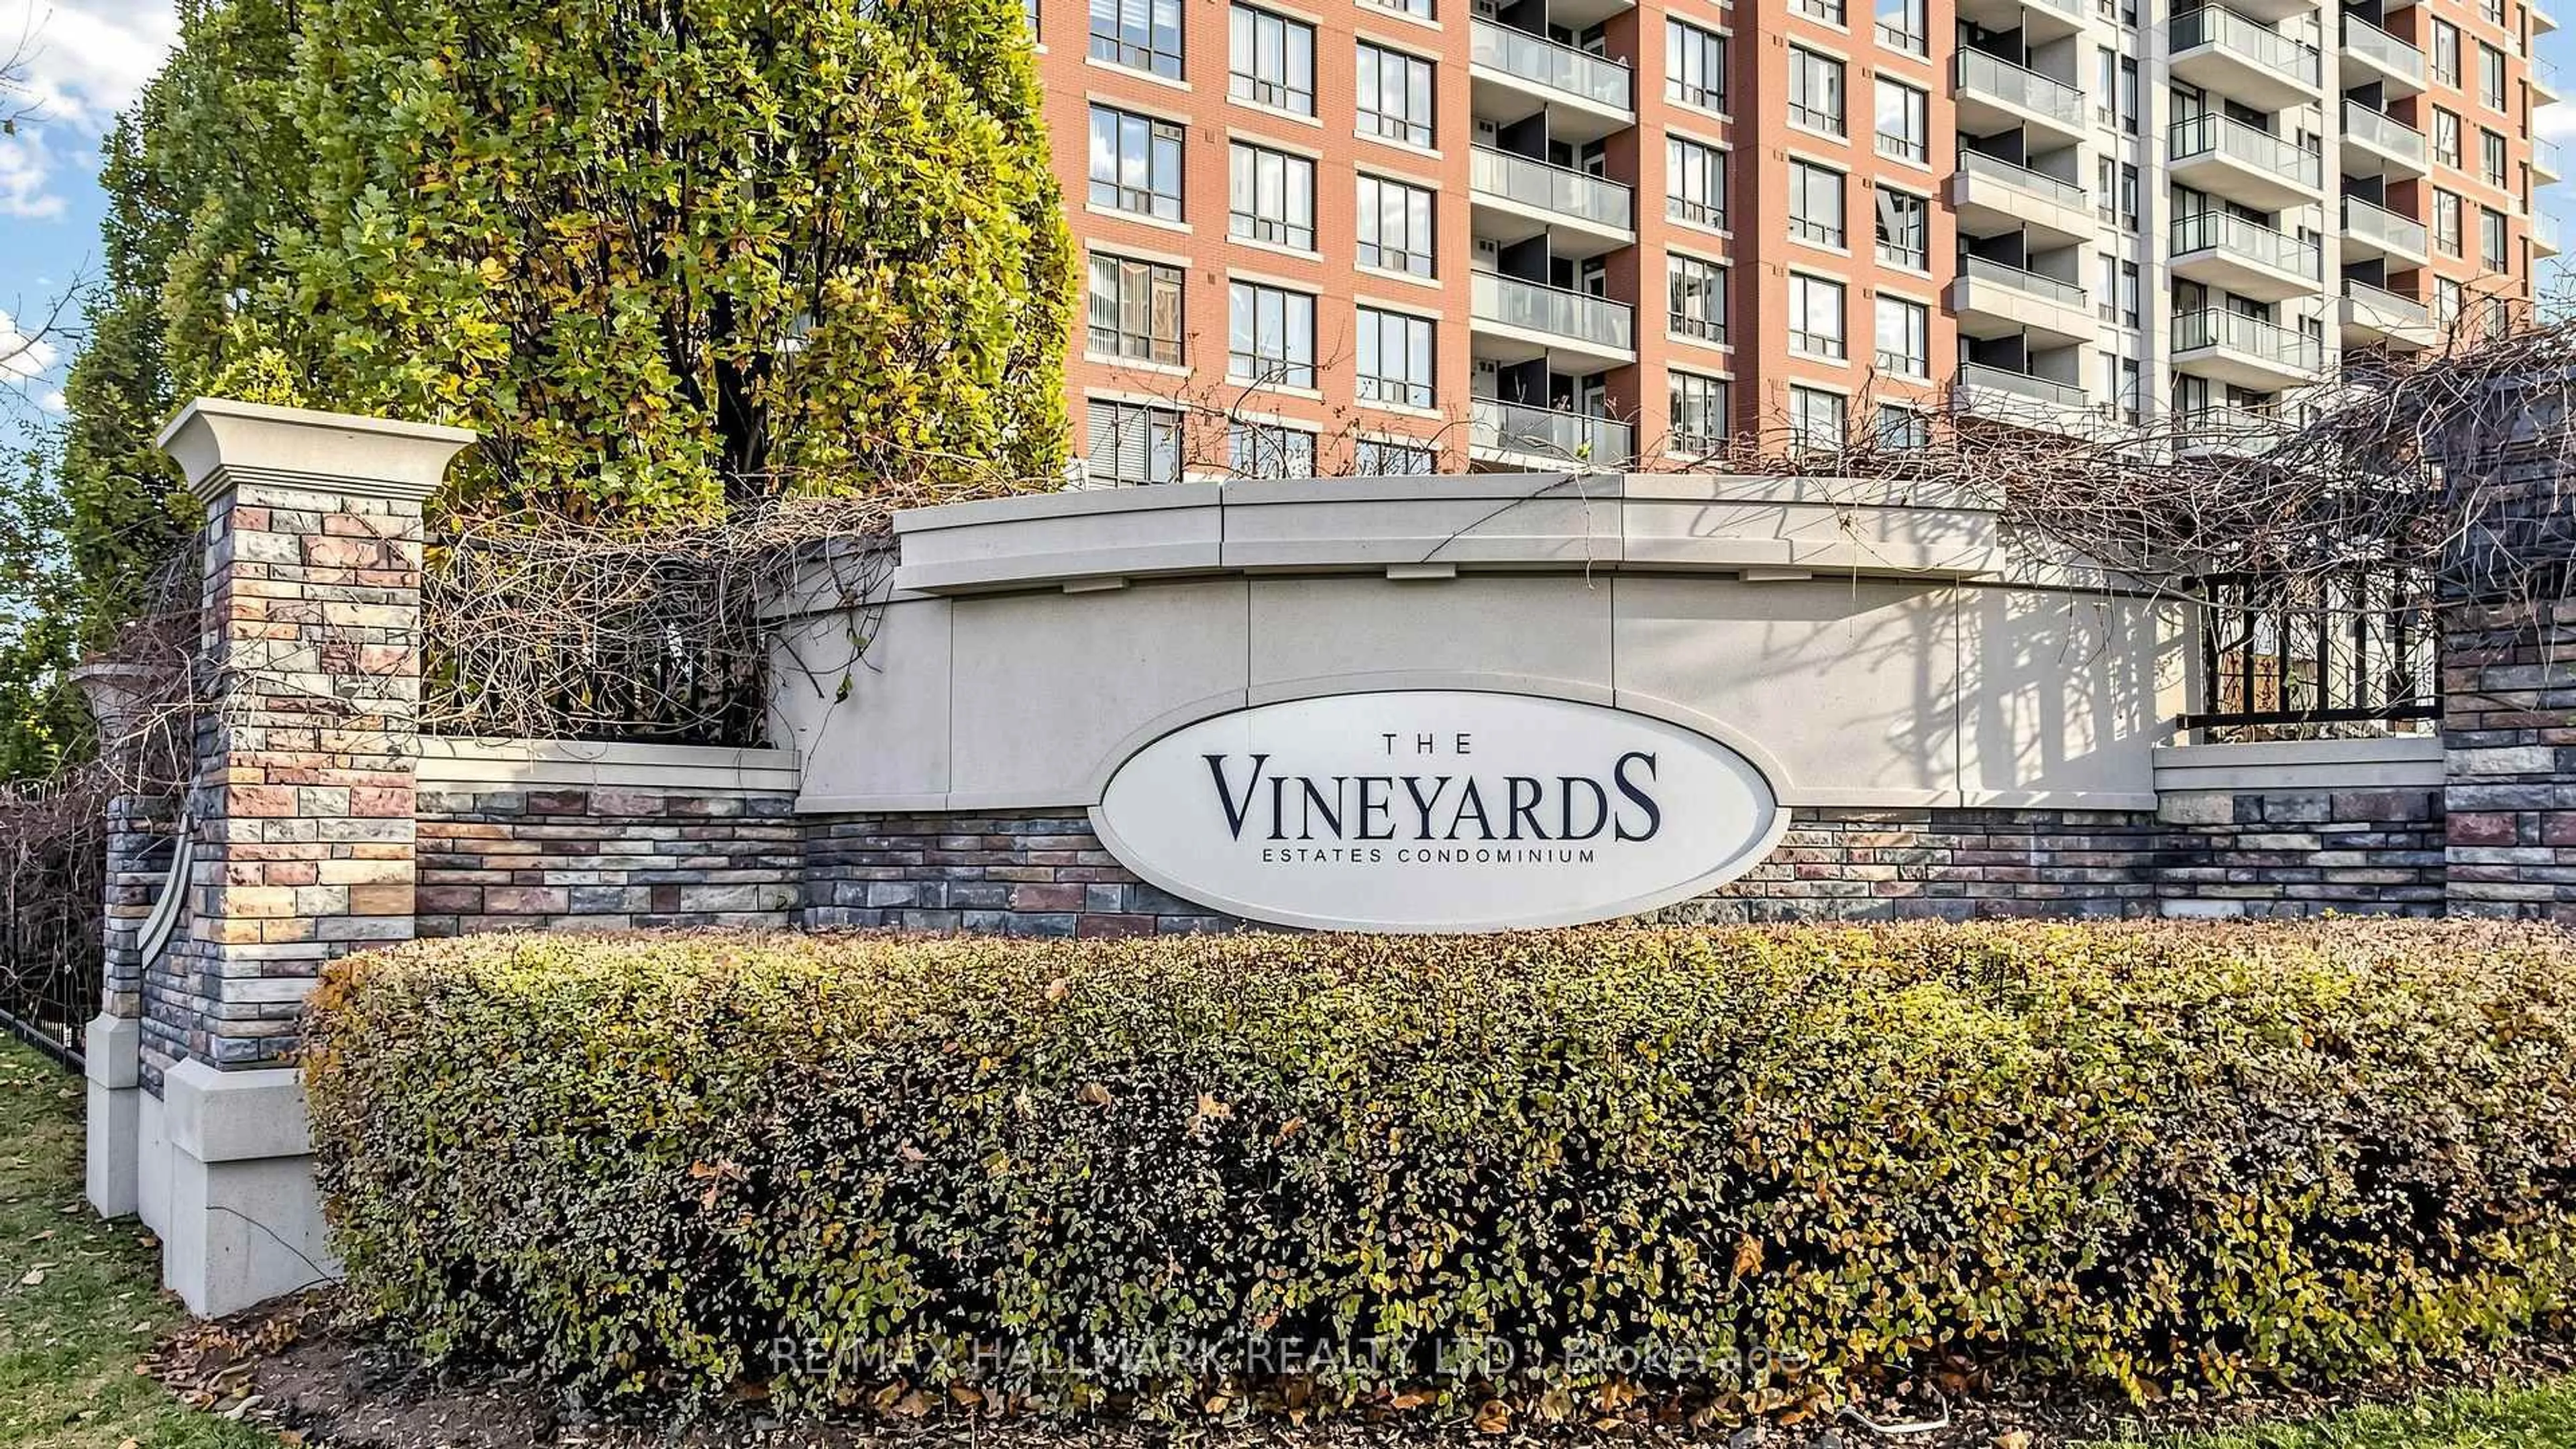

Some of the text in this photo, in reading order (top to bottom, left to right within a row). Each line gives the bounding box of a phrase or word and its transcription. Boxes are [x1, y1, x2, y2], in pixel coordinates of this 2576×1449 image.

[1381, 733, 1471, 755] THE
[1263, 849, 1594, 863] ESTATES CONDOMINIUM
